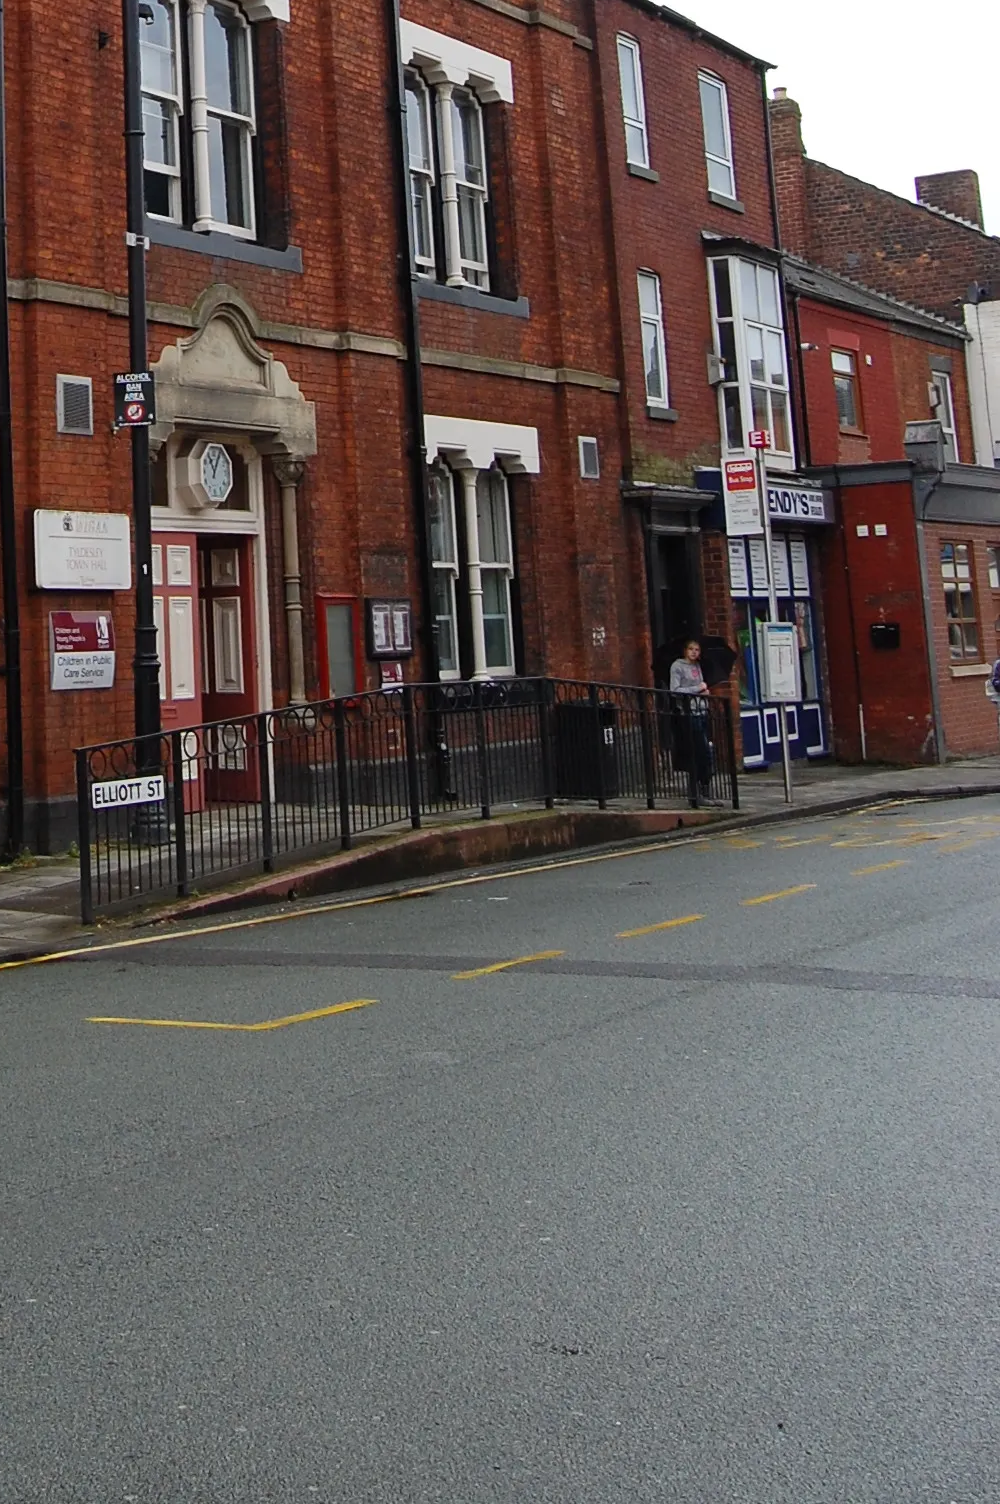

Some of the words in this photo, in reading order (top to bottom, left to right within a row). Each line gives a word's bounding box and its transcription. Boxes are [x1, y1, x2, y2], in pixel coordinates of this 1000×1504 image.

[116, 373, 151, 383] ALCOHOL
[124, 393, 145, 401] AREA
[750, 432, 763, 445] E
[729, 476, 740, 484] Bus
[740, 476, 753, 484] Stop
[768, 489, 809, 516] ENDY'S
[68, 547, 104, 558] TYLDESLEY
[65, 559, 88, 570] TOWN
[91, 560, 107, 571] HALL
[142, 564, 147, 575] 1
[58, 657, 84, 666] Children
[85, 657, 91, 665] in
[93, 656, 112, 665] Public
[64, 669, 79, 678] Care
[81, 668, 104, 677] Service
[94, 783, 142, 804] ELLIOTT
[148, 780, 161, 797] ST
